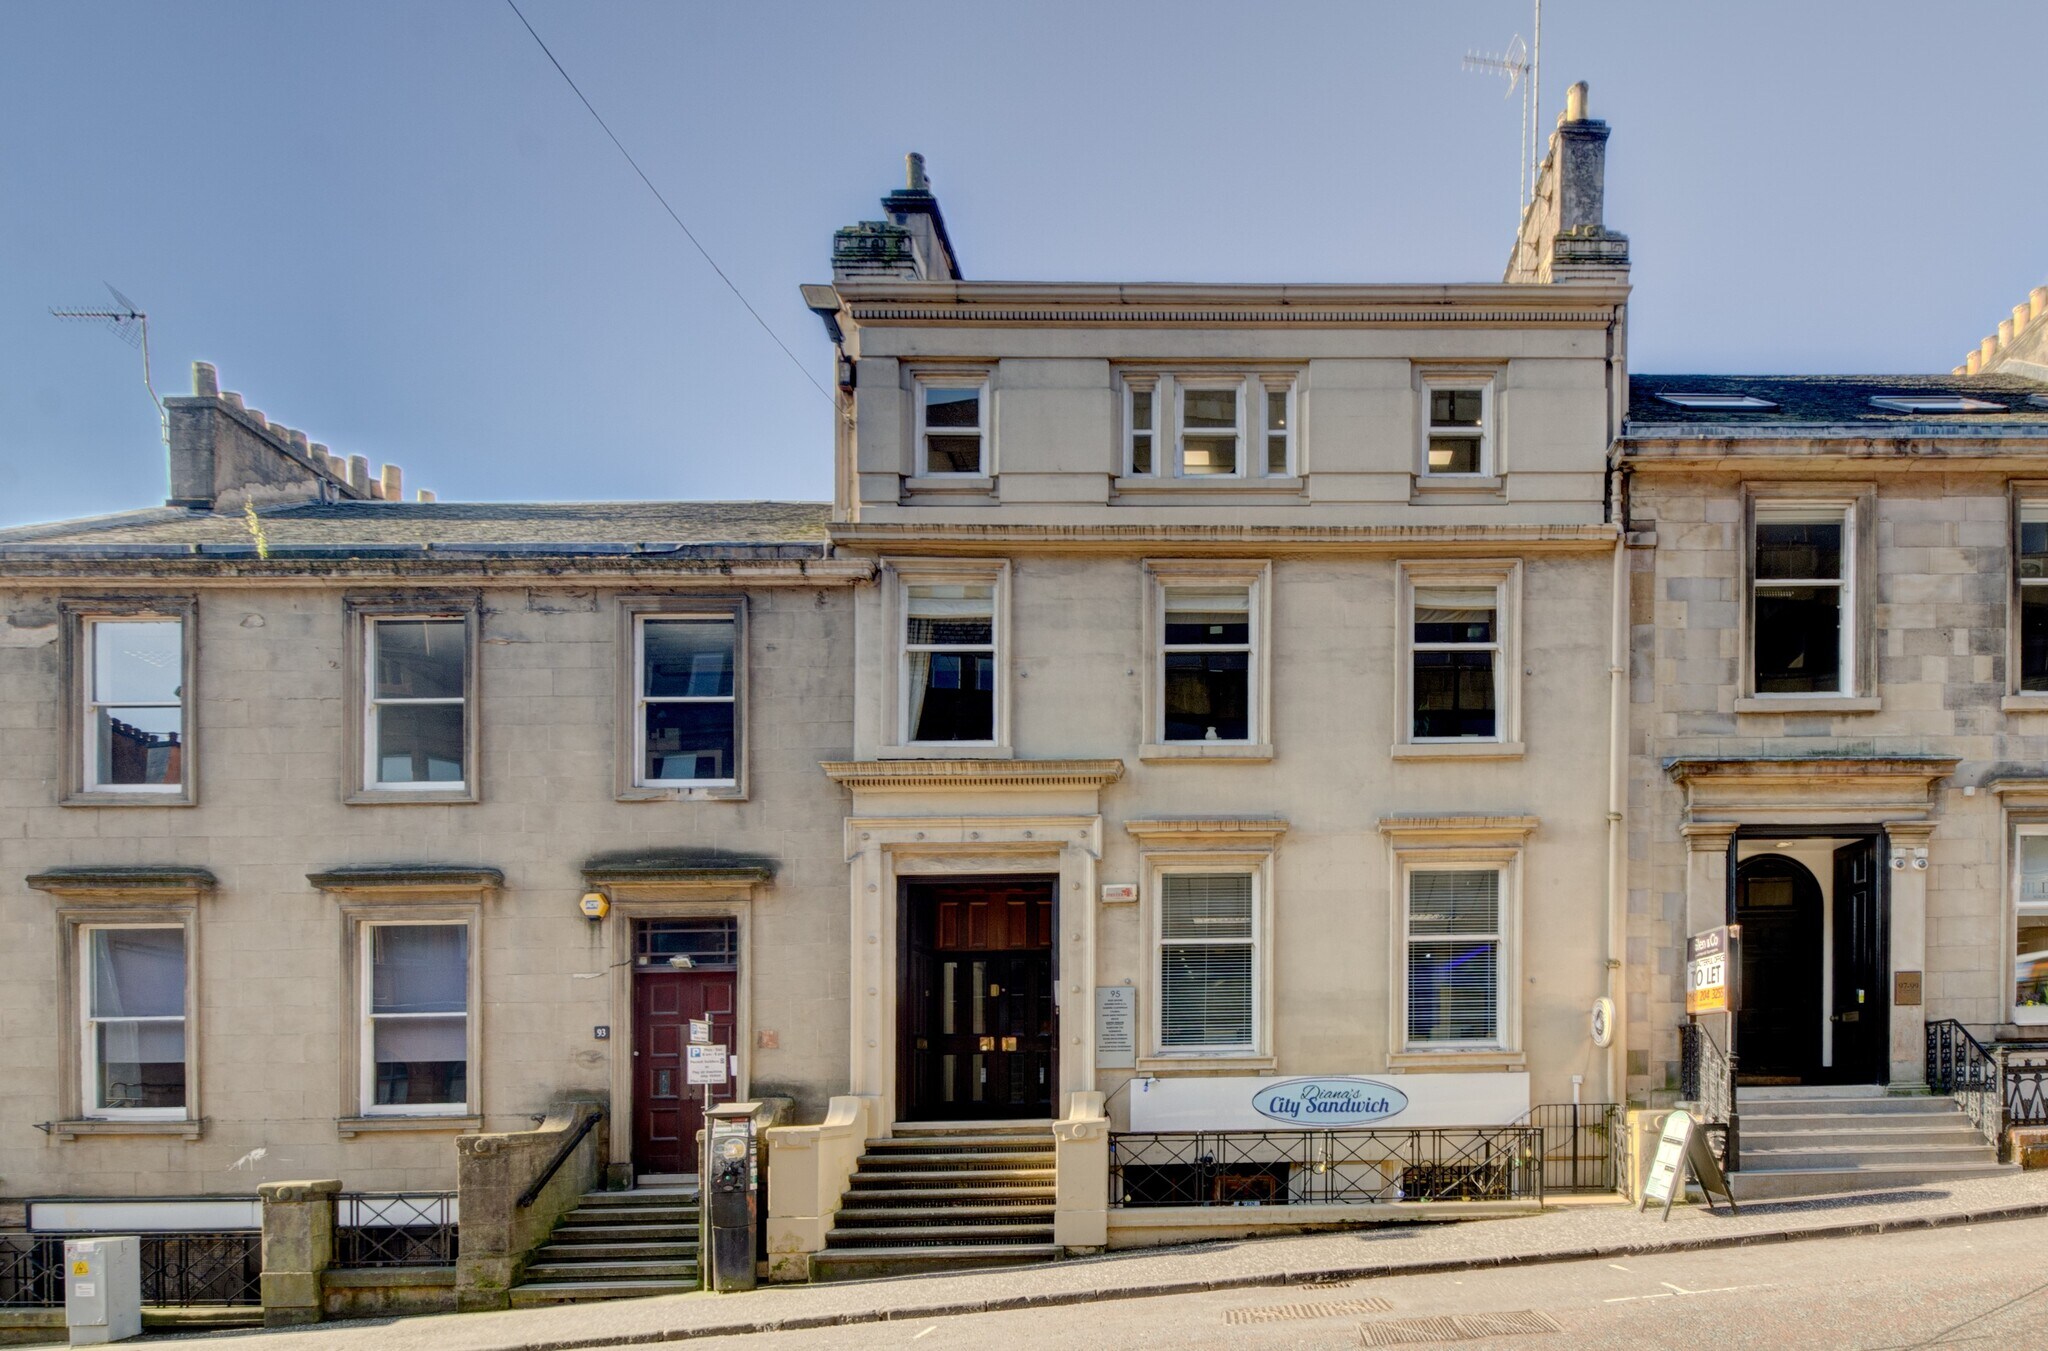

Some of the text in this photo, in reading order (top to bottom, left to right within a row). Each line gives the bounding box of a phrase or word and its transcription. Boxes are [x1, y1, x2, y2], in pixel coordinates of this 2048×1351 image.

[1691, 965, 1721, 988] TO LET
[1110, 990, 1121, 998] 95
[596, 1028, 606, 1037] 93
[1300, 1084, 1361, 1100] Diana's
[1269, 1096, 1389, 1118] City Sandwich
